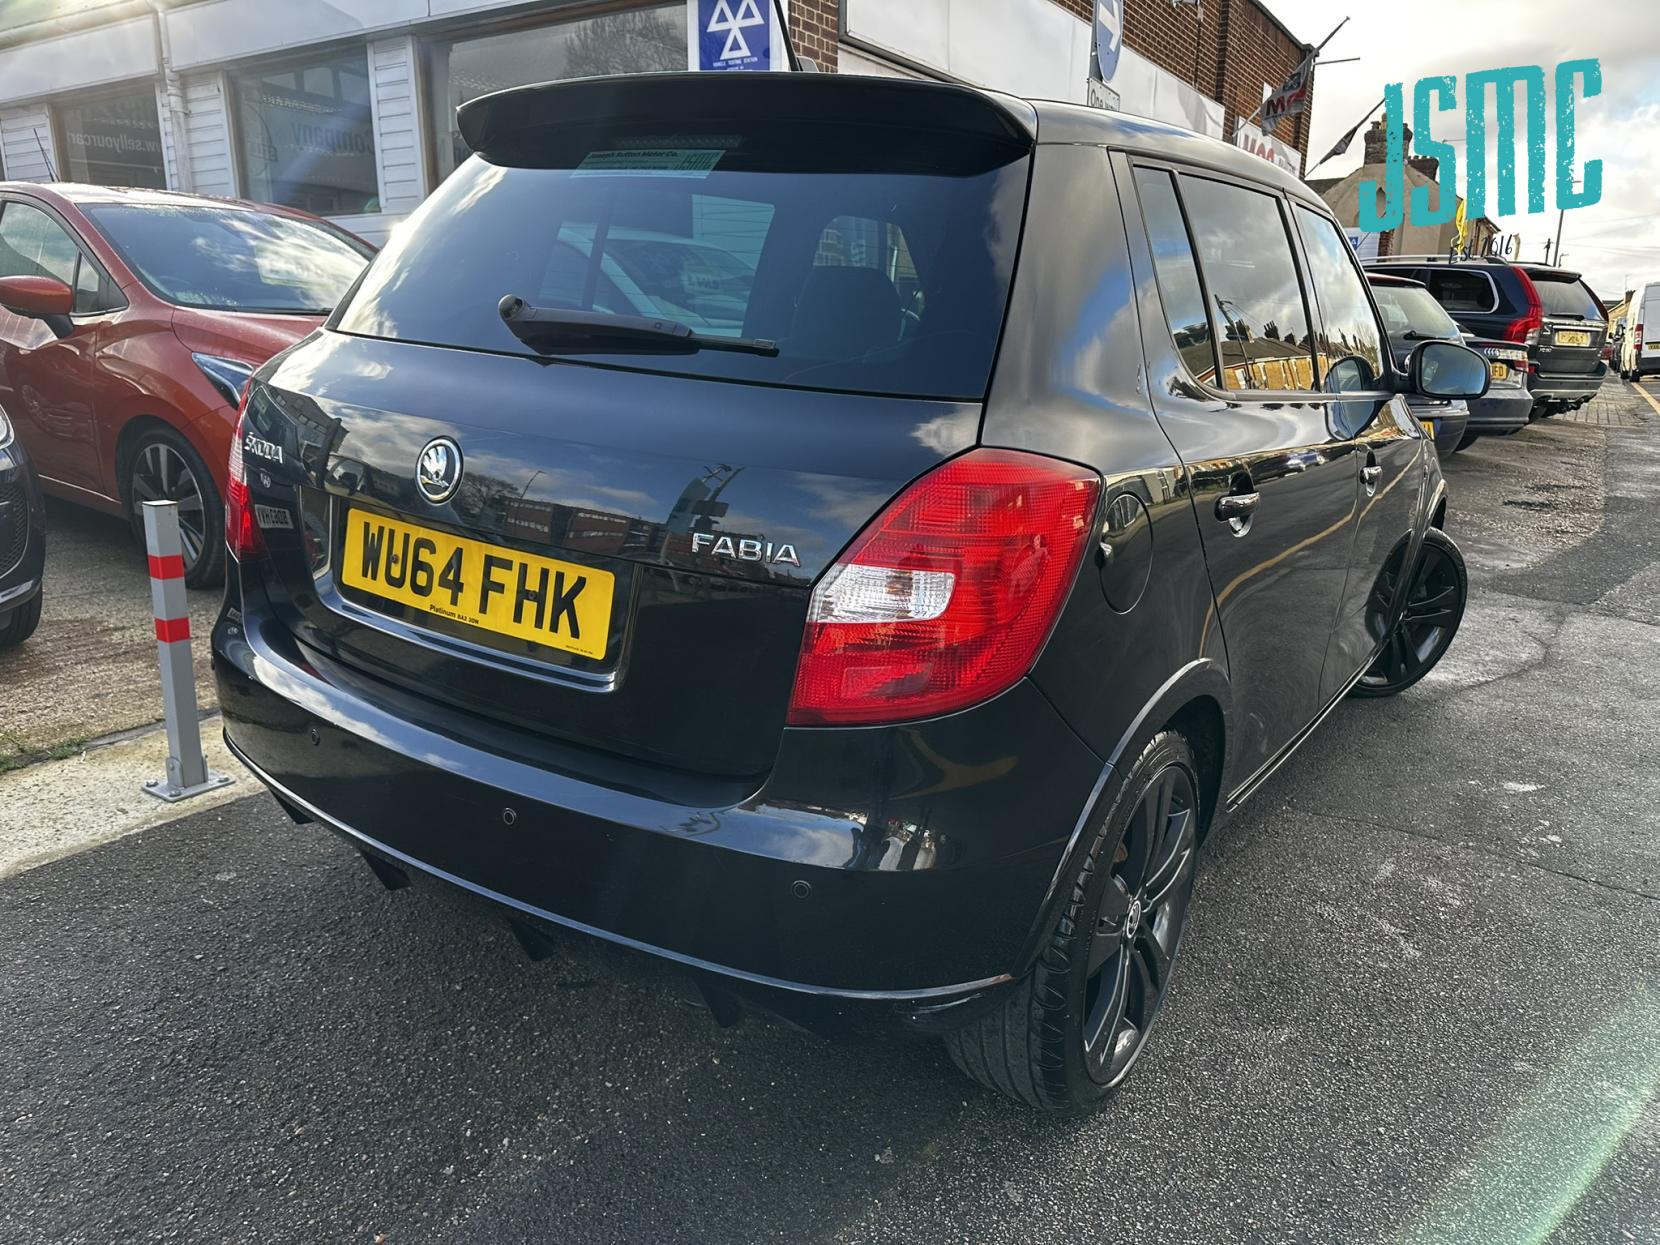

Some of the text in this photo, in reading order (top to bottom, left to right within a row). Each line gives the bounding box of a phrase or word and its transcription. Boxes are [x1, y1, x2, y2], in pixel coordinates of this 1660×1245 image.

[361, 520, 587, 640] WU64 FHK
[691, 532, 800, 567] FABIA
